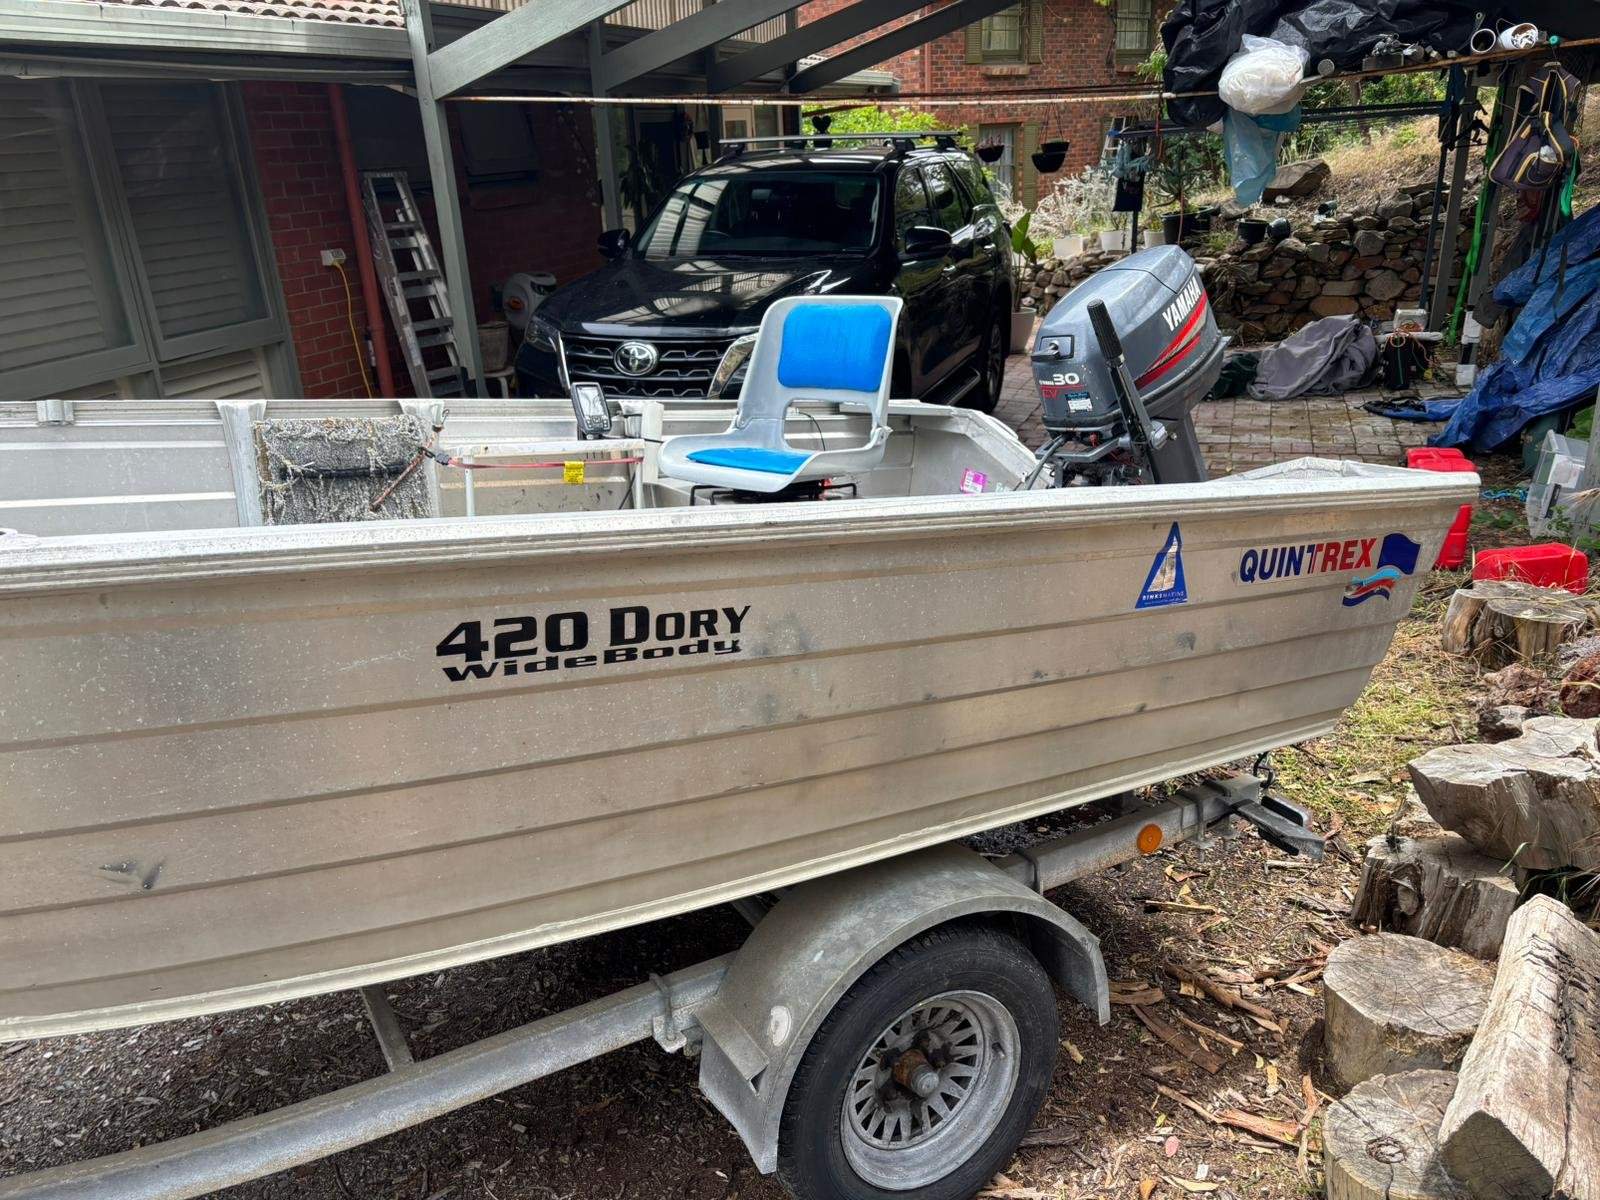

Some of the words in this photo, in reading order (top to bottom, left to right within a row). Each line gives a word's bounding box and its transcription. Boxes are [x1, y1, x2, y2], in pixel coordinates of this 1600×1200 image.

[1161, 275, 1202, 331] YAMAHA
[1052, 372, 1080, 386] 30
[1239, 537, 1377, 583] QUINTREX
[436, 611, 588, 662] 420
[442, 639, 743, 682] WideBody
